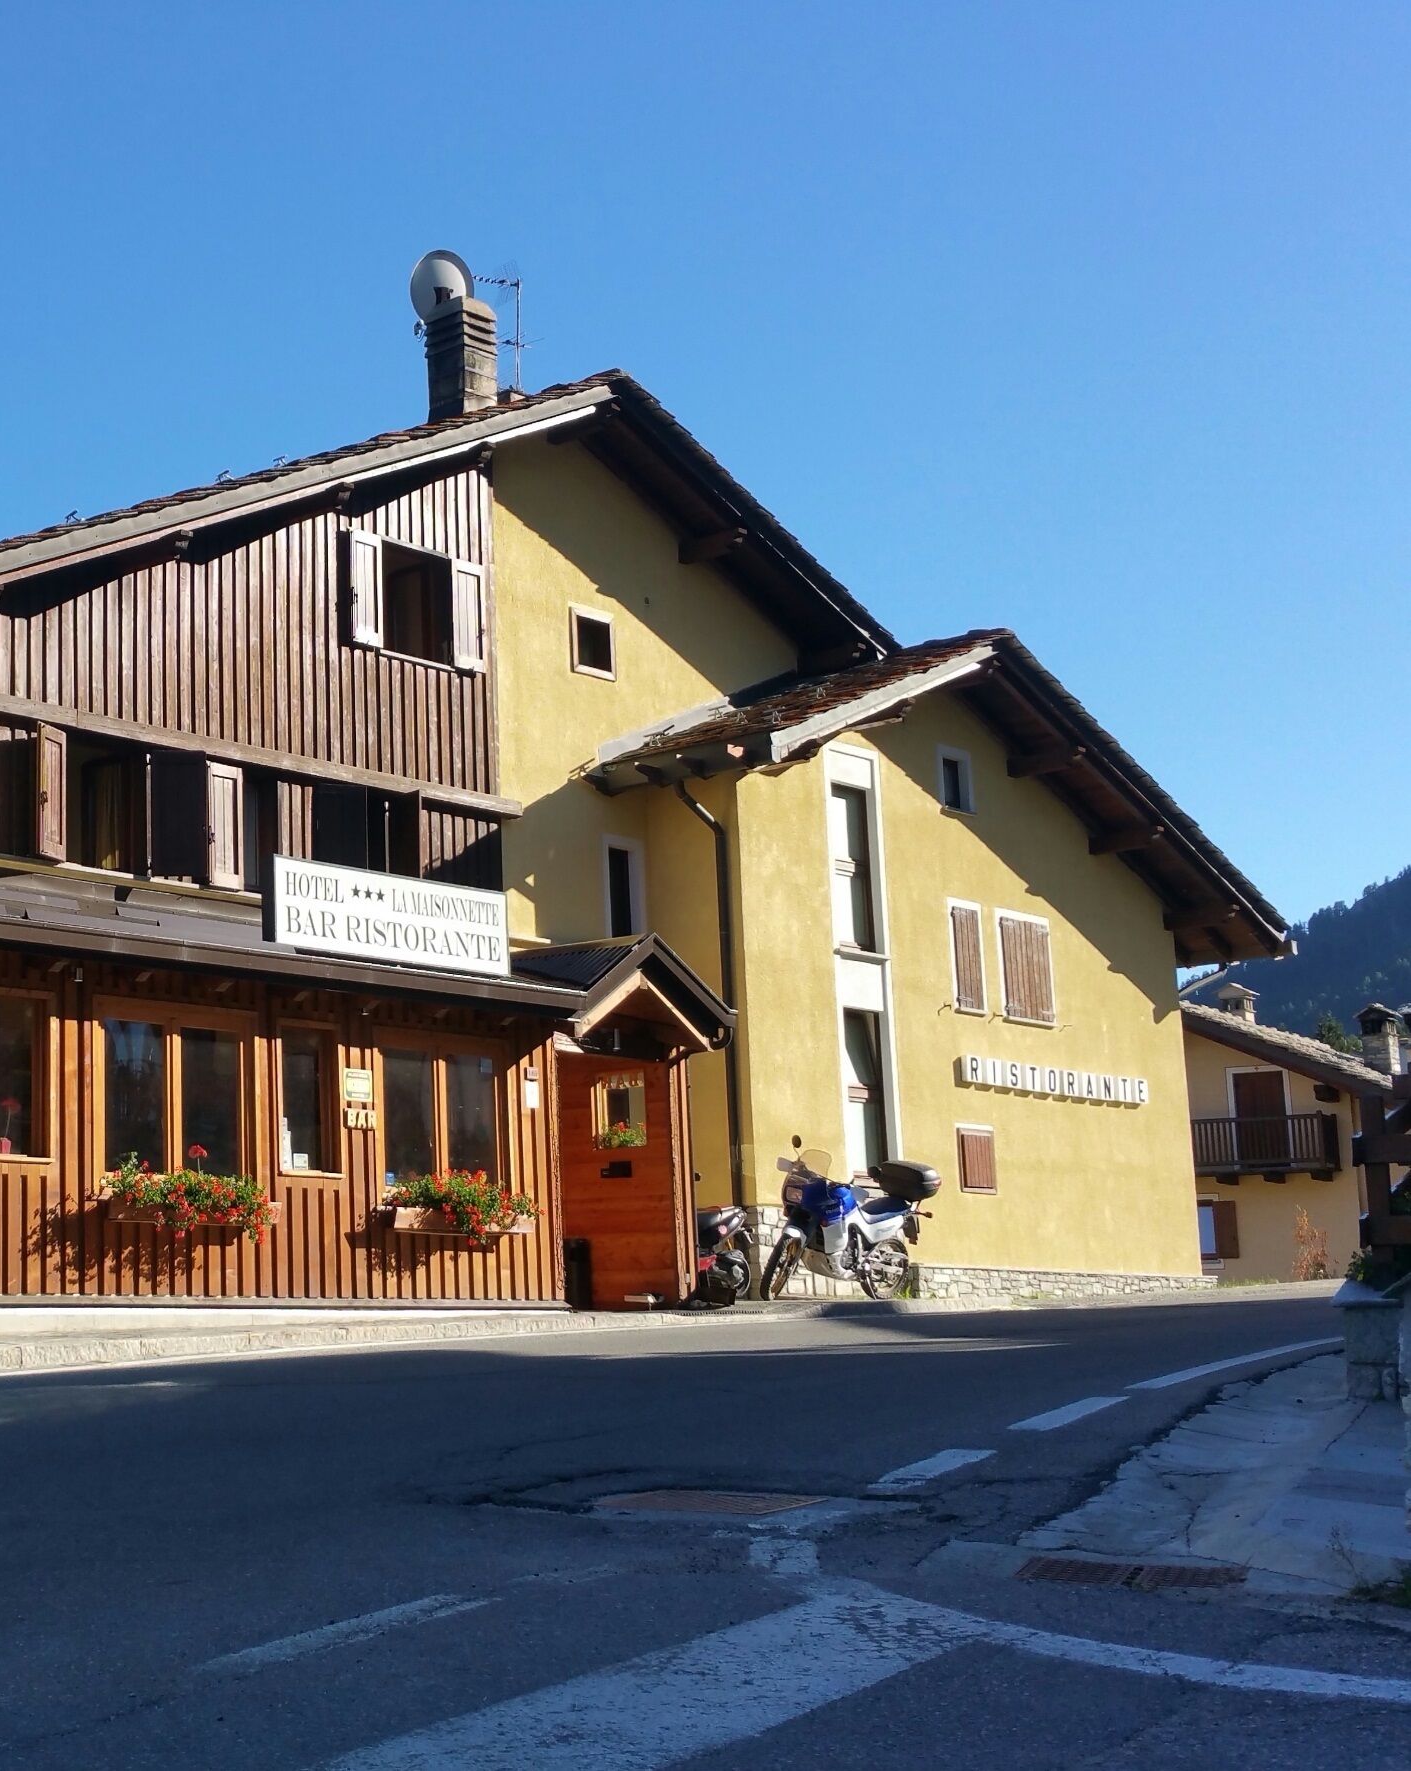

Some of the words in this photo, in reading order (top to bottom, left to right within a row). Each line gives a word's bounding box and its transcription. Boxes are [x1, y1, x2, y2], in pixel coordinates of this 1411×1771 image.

[285, 870, 344, 903] HOTEL
[392, 888, 408, 914] LA
[410, 891, 499, 927] MAISONNETTE
[286, 905, 337, 939] BAR
[346, 915, 501, 962] RISTORANTE
[970, 1057, 1146, 1103] RISTORANTE
[346, 1108, 377, 1130] BAR
